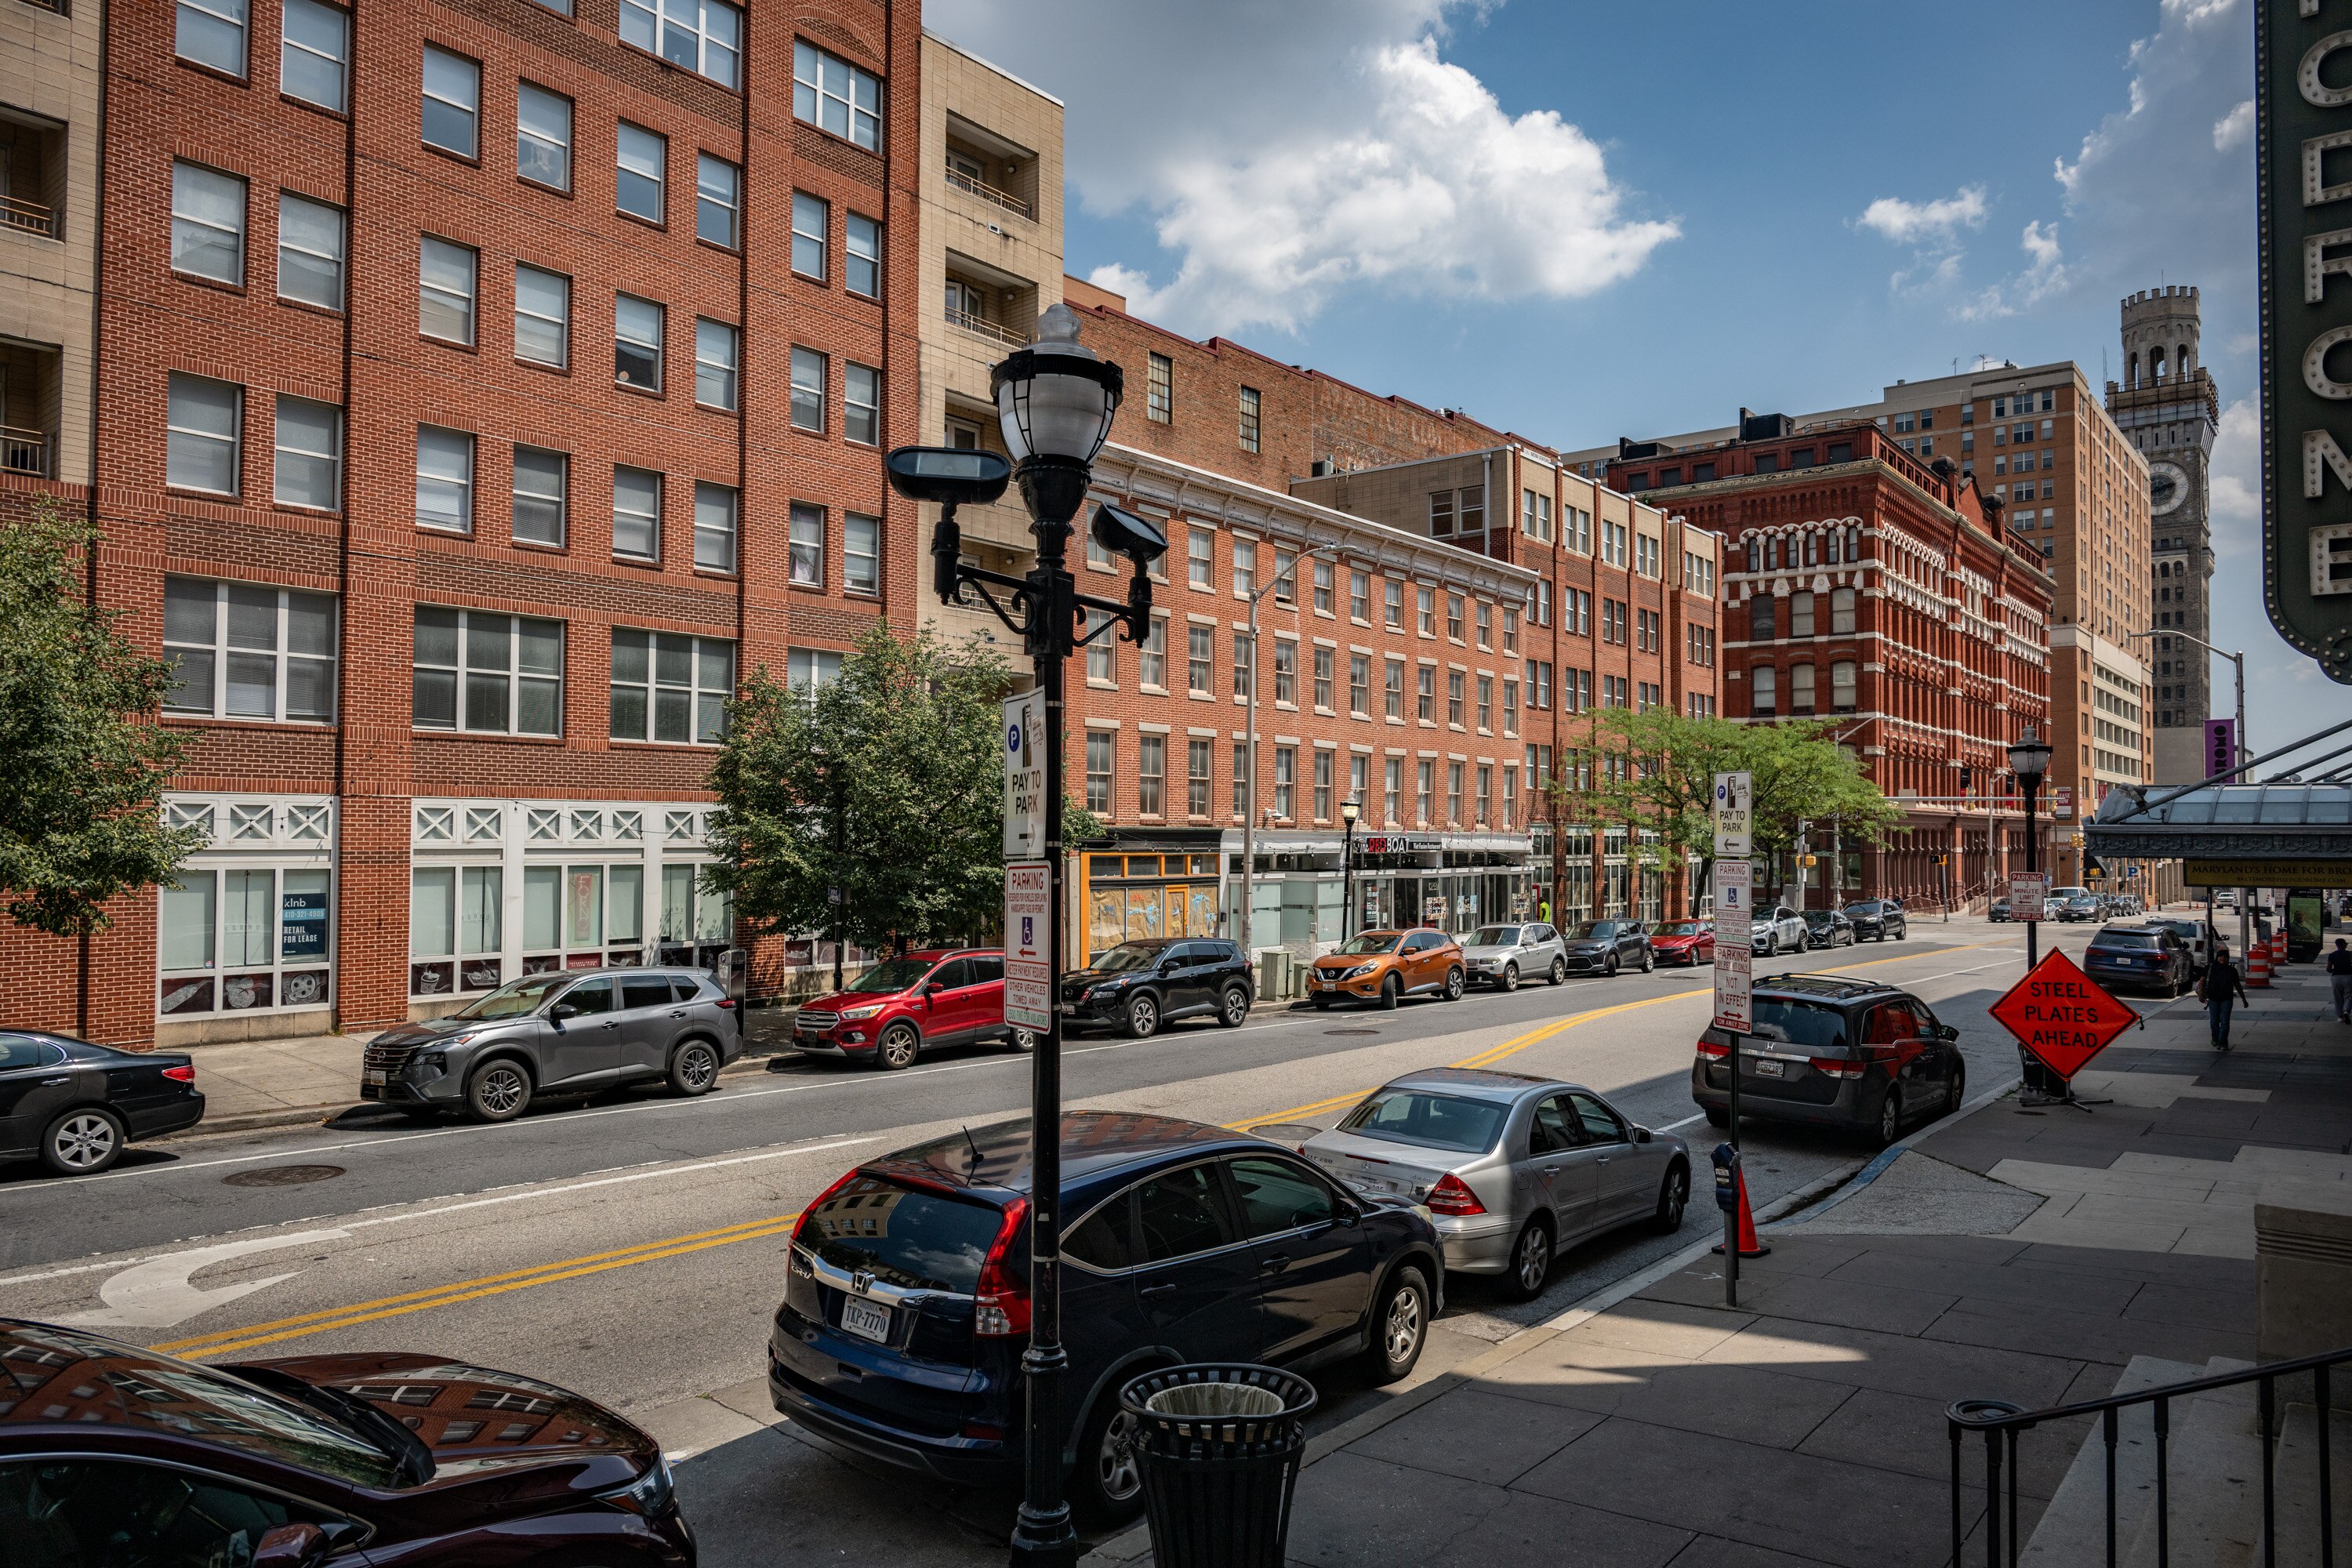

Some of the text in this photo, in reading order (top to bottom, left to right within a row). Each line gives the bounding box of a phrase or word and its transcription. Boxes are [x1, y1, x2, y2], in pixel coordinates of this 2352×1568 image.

[2297, 0, 2352, 596] ODROME
[1011, 731, 1017, 746] P
[1012, 770, 1041, 792] PAY TO
[1719, 788, 1724, 797] P
[1015, 793, 1038, 815] PARK
[1719, 810, 1745, 821] PAY TO
[1722, 822, 1743, 833] PARK
[1369, 837, 1387, 853] RED
[1387, 837, 1410, 853] BOAT
[1719, 865, 1746, 876] PARKING
[2127, 866, 2138, 877] P
[2192, 865, 2261, 874] MARYLAND'S
[2263, 866, 2299, 874] HOME
[2302, 866, 2326, 875] FOR
[1012, 871, 1044, 891] PARKING
[285, 898, 307, 908] klnb
[578, 876, 590, 930] FORNO
[284, 909, 325, 919] 410-321-4905
[1717, 948, 1748, 963] PARKING
[1008, 964, 1018, 975] METER
[1018, 965, 1032, 978] PAYMENT
[1737, 964, 1748, 972] ONLY
[1009, 982, 1046, 996] OTHER VEHICLES
[1726, 976, 1738, 989] NOT
[2030, 982, 2091, 999] STEEL
[1013, 994, 1042, 1007] TOWED AWAY
[1718, 992, 1748, 1008] IN EFFECT
[2025, 1005, 2099, 1024] PLATES
[1717, 1018, 1749, 1031] TOW AWAY ZONE
[2031, 1030, 2098, 1048] AHEAD
[857, 1301, 878, 1313] VIRGINIA
[846, 1305, 886, 1333] TKP-7770
